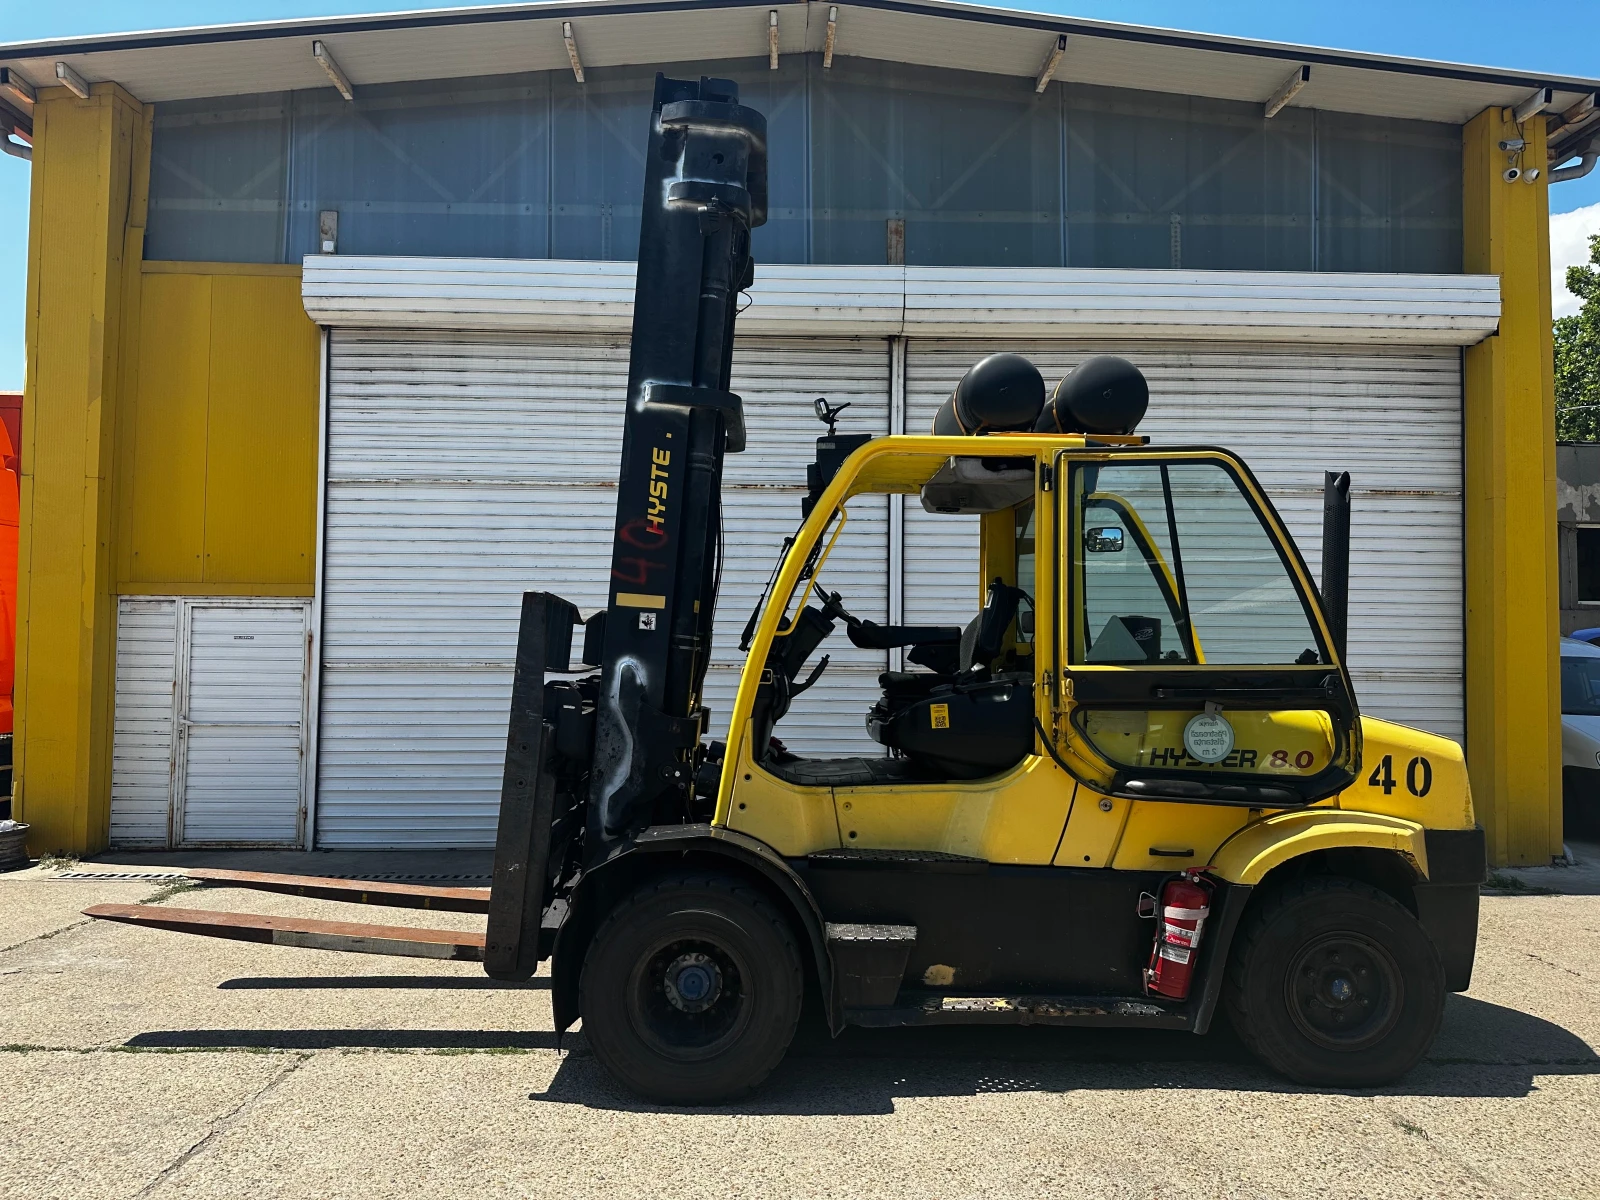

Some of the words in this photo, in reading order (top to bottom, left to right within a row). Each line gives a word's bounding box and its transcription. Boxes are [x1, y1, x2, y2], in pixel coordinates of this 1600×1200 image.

[645, 432, 672, 535] HYSTE
[1149, 747, 1258, 768] HYER
[1269, 749, 1315, 769] 8.0
[1368, 754, 1433, 798] 40
